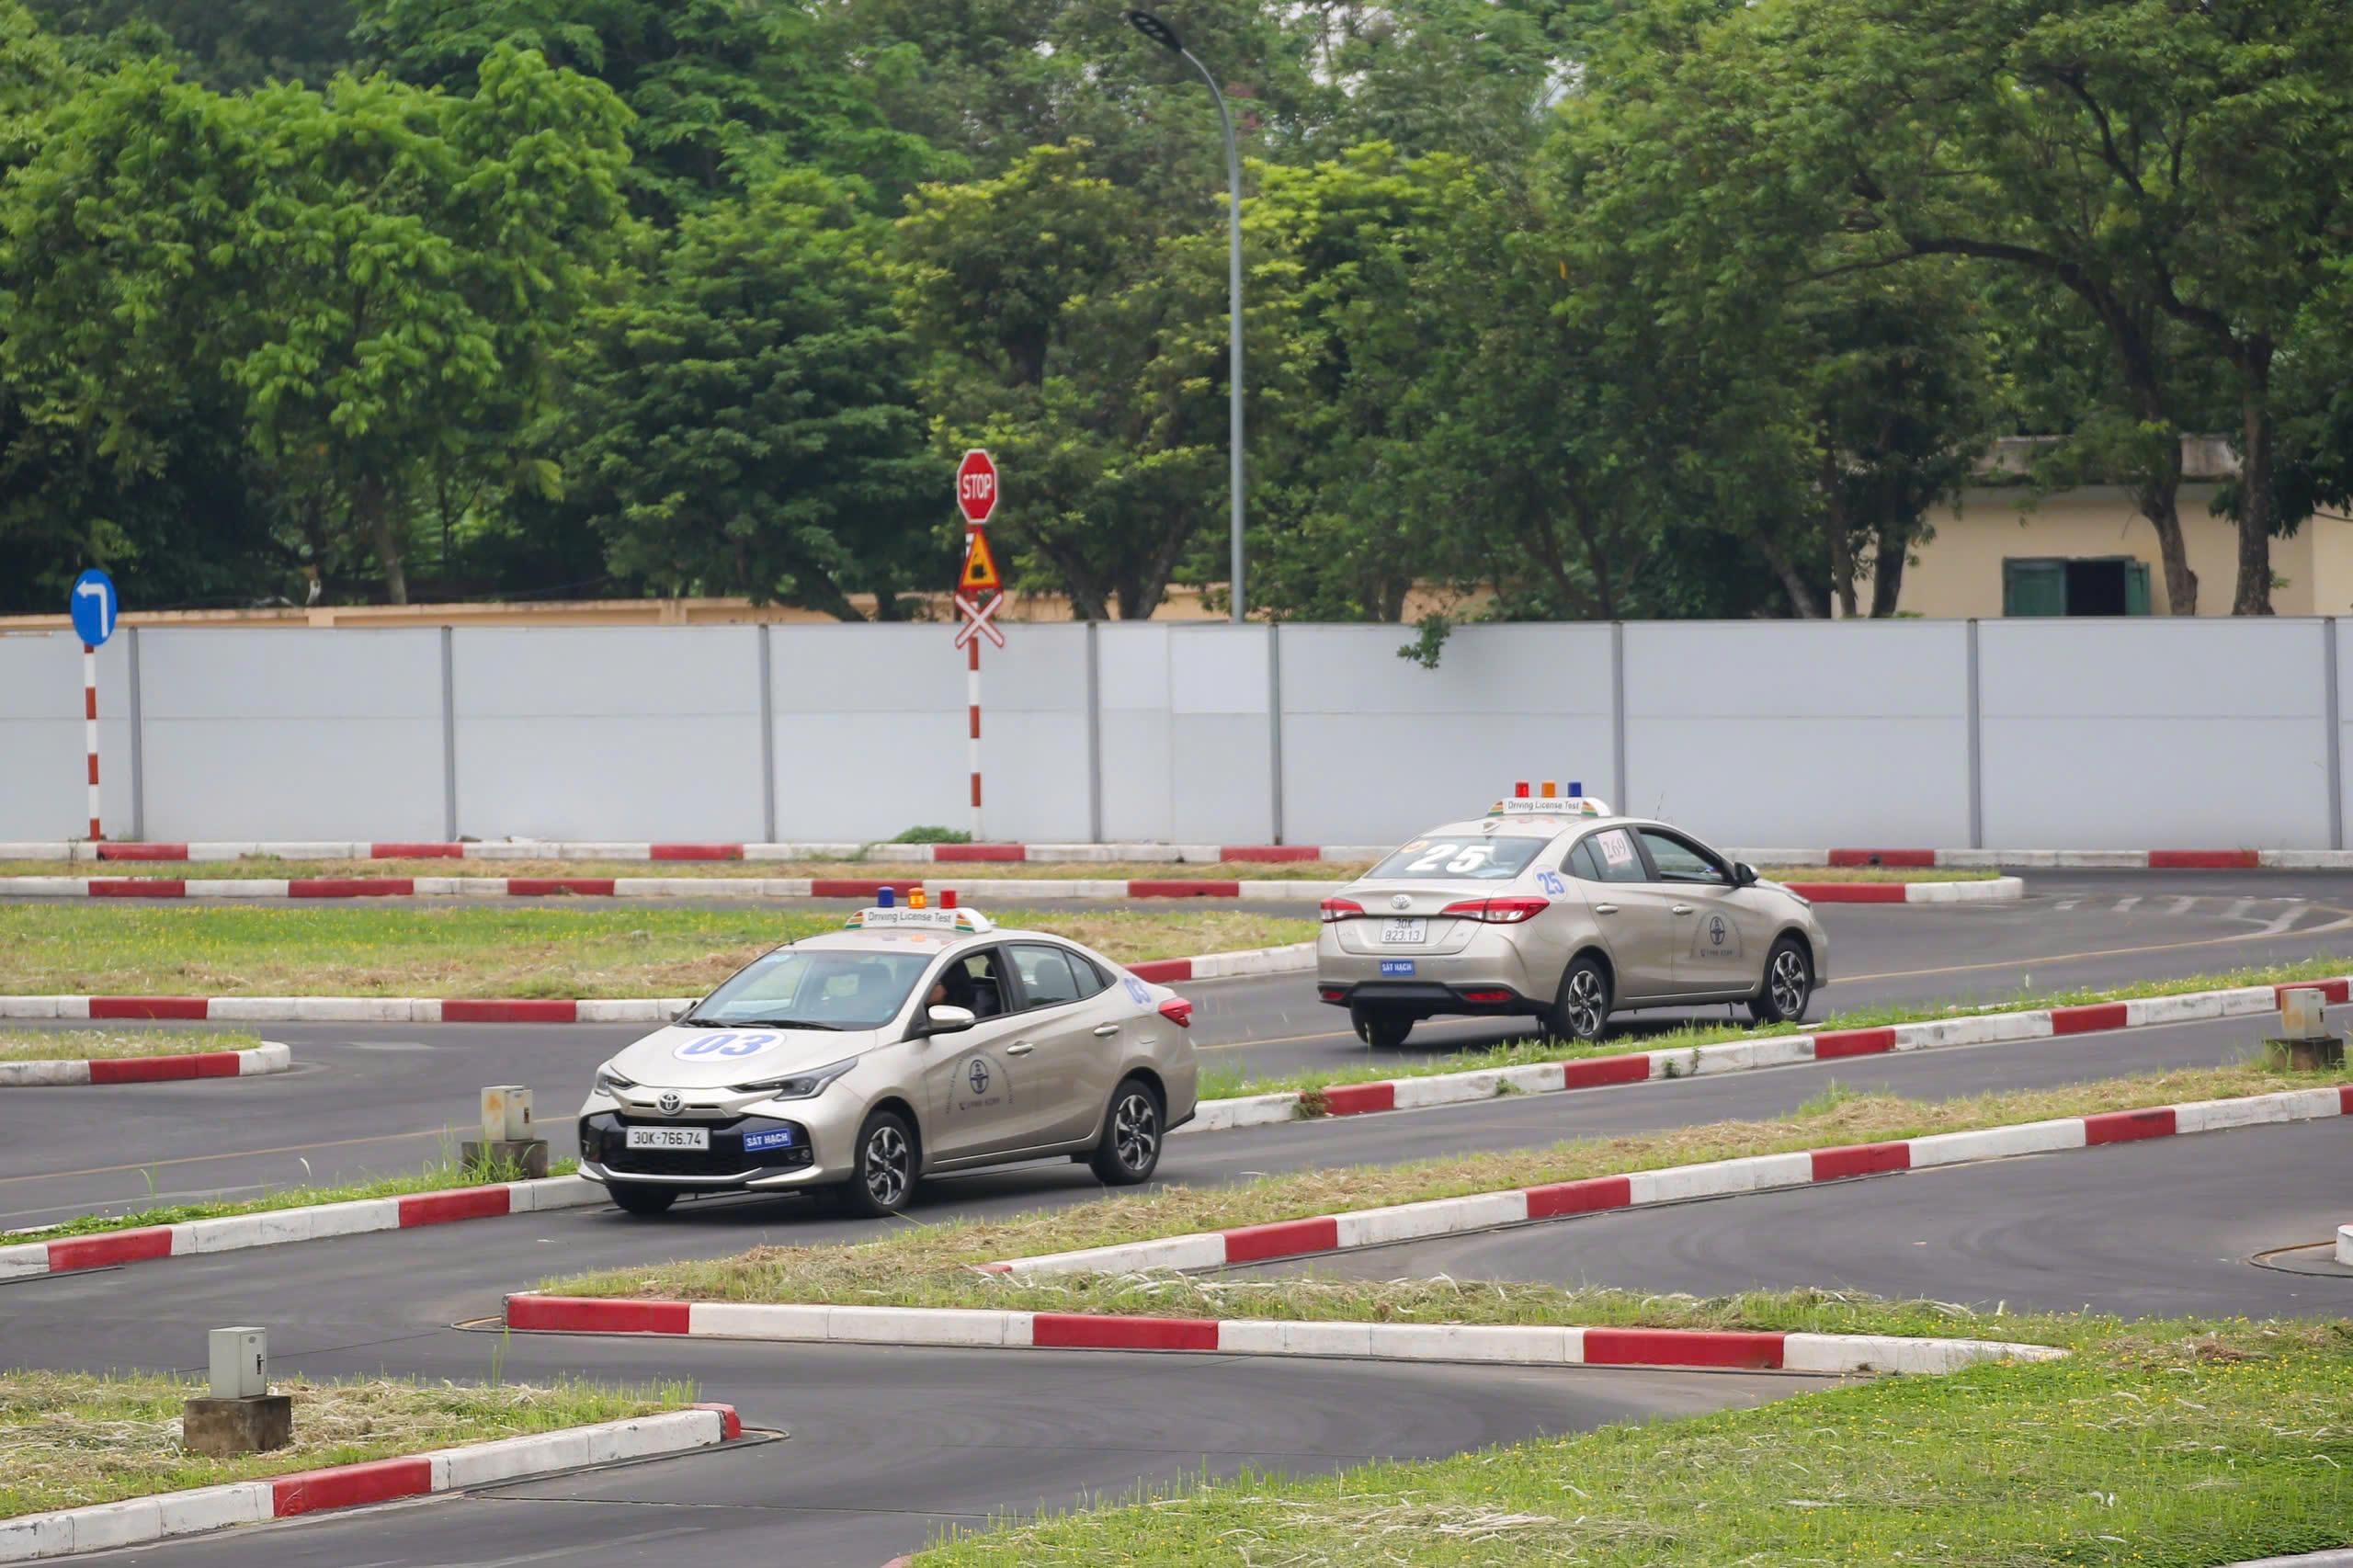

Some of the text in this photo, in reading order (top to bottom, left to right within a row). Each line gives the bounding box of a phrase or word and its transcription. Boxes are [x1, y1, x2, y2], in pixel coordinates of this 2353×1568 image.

[962, 473, 993, 500] STOP
[1507, 801, 1579, 811] Driving License Test
[1603, 837, 1626, 858] 269
[1404, 844, 1495, 873] 25
[1536, 872, 1565, 895] 25
[869, 911, 951, 923] Driving License Test
[1384, 930, 1420, 941] 823.13
[683, 1034, 776, 1056] 03
[633, 1131, 701, 1145] 30K-766.74
[746, 1132, 789, 1147] SÁT HẠCH
